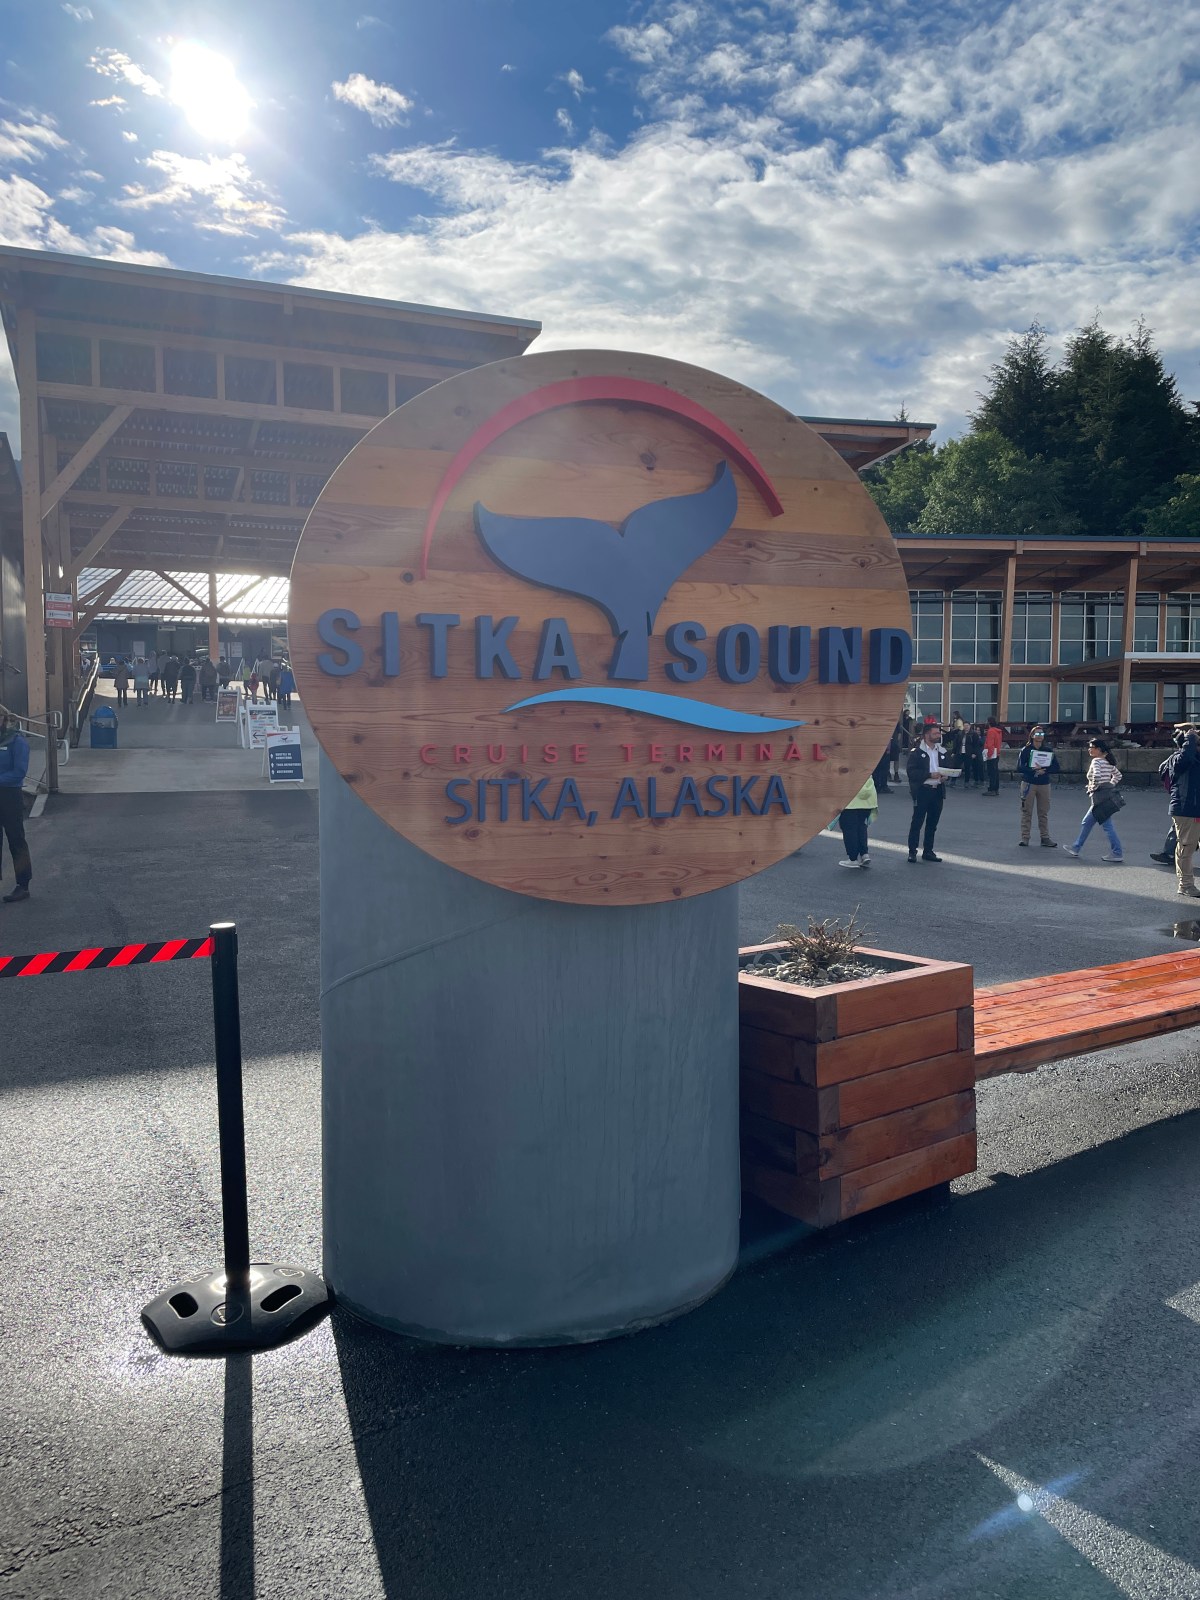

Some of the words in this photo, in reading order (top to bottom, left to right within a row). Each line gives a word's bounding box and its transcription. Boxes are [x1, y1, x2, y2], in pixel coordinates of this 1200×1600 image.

[317, 608, 582, 680] SITKA
[664, 621, 913, 684] SOUND
[420, 743, 589, 764] CRUISE
[621, 743, 828, 763] TERMINAL
[445, 777, 598, 827] SITKA,
[611, 774, 792, 819] ALASKA
